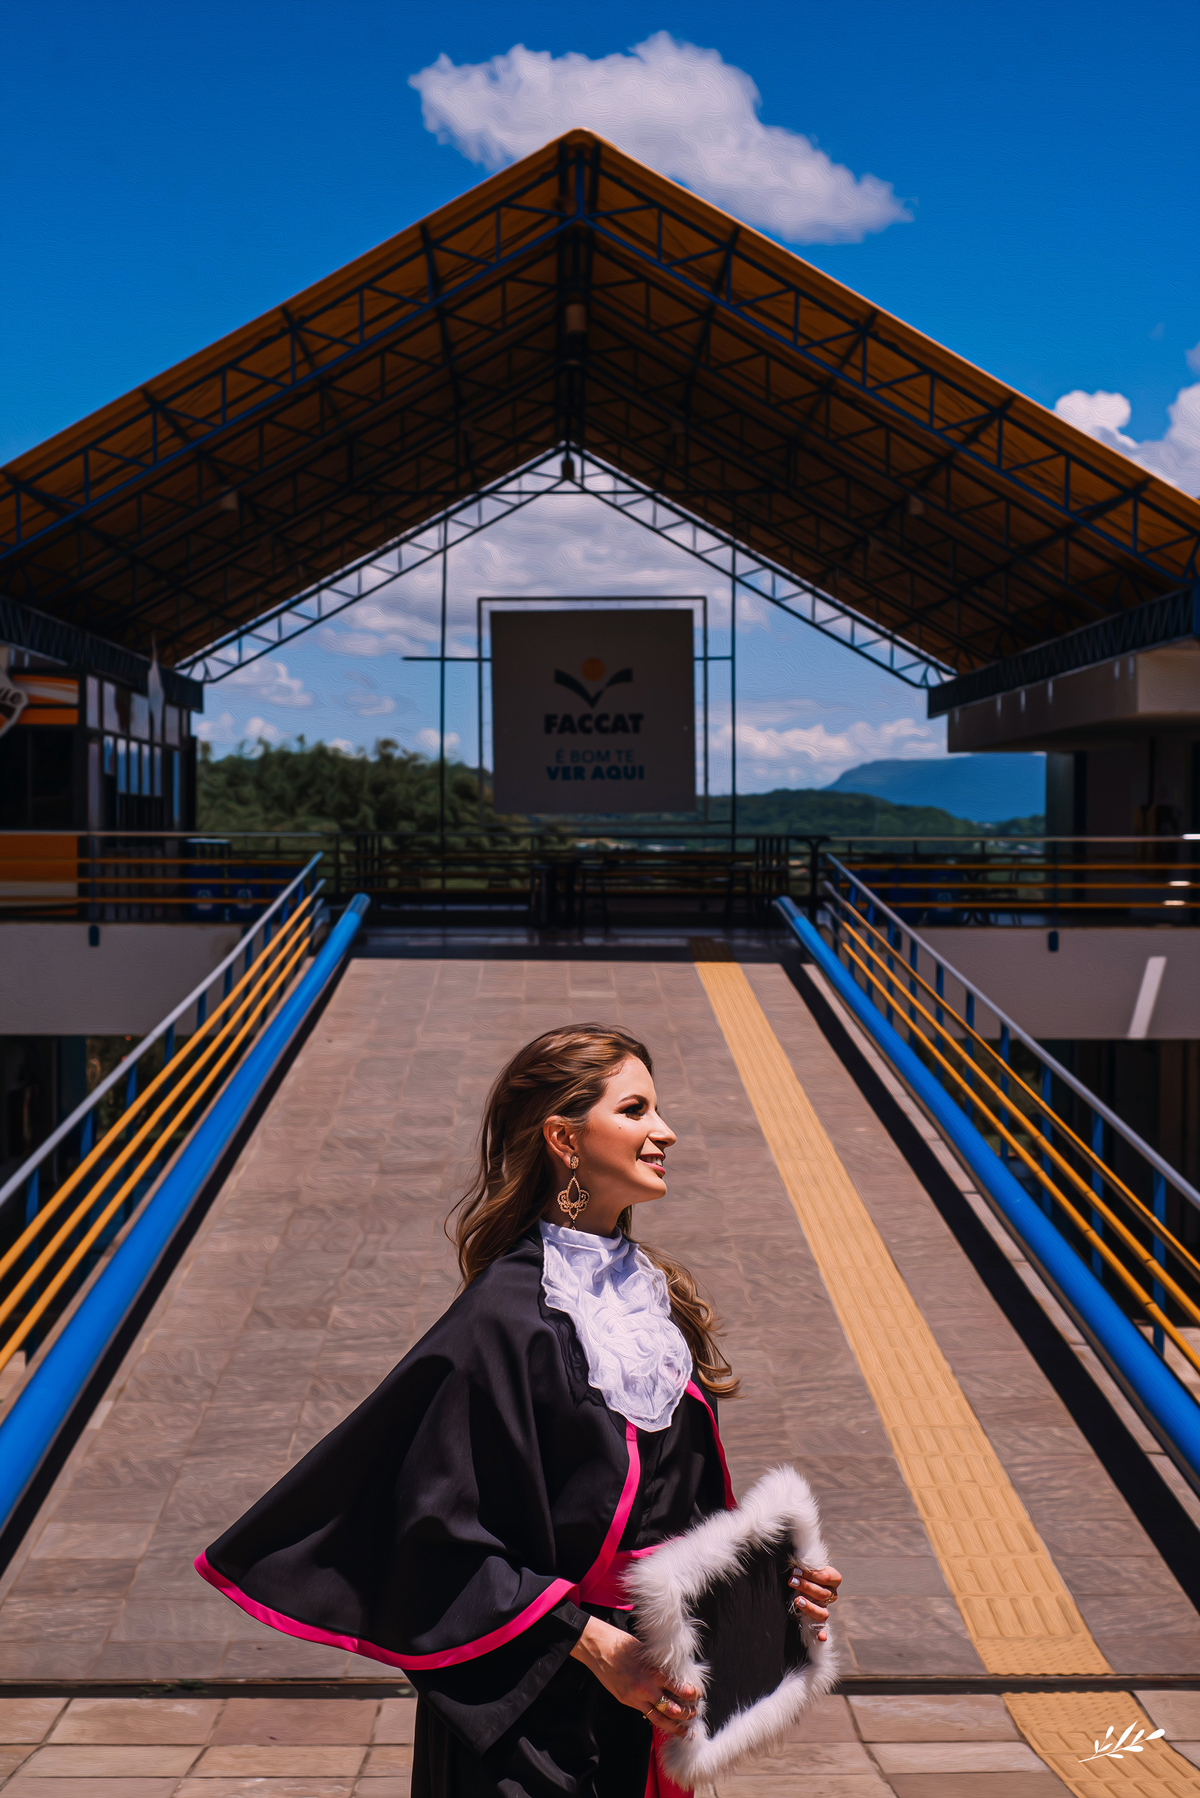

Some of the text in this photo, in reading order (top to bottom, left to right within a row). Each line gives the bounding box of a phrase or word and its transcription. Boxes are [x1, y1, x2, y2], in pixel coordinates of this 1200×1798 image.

[544, 713, 644, 735] FACCAT
[555, 747, 636, 764] É BOM TE
[546, 765, 646, 781] VER AQUI
